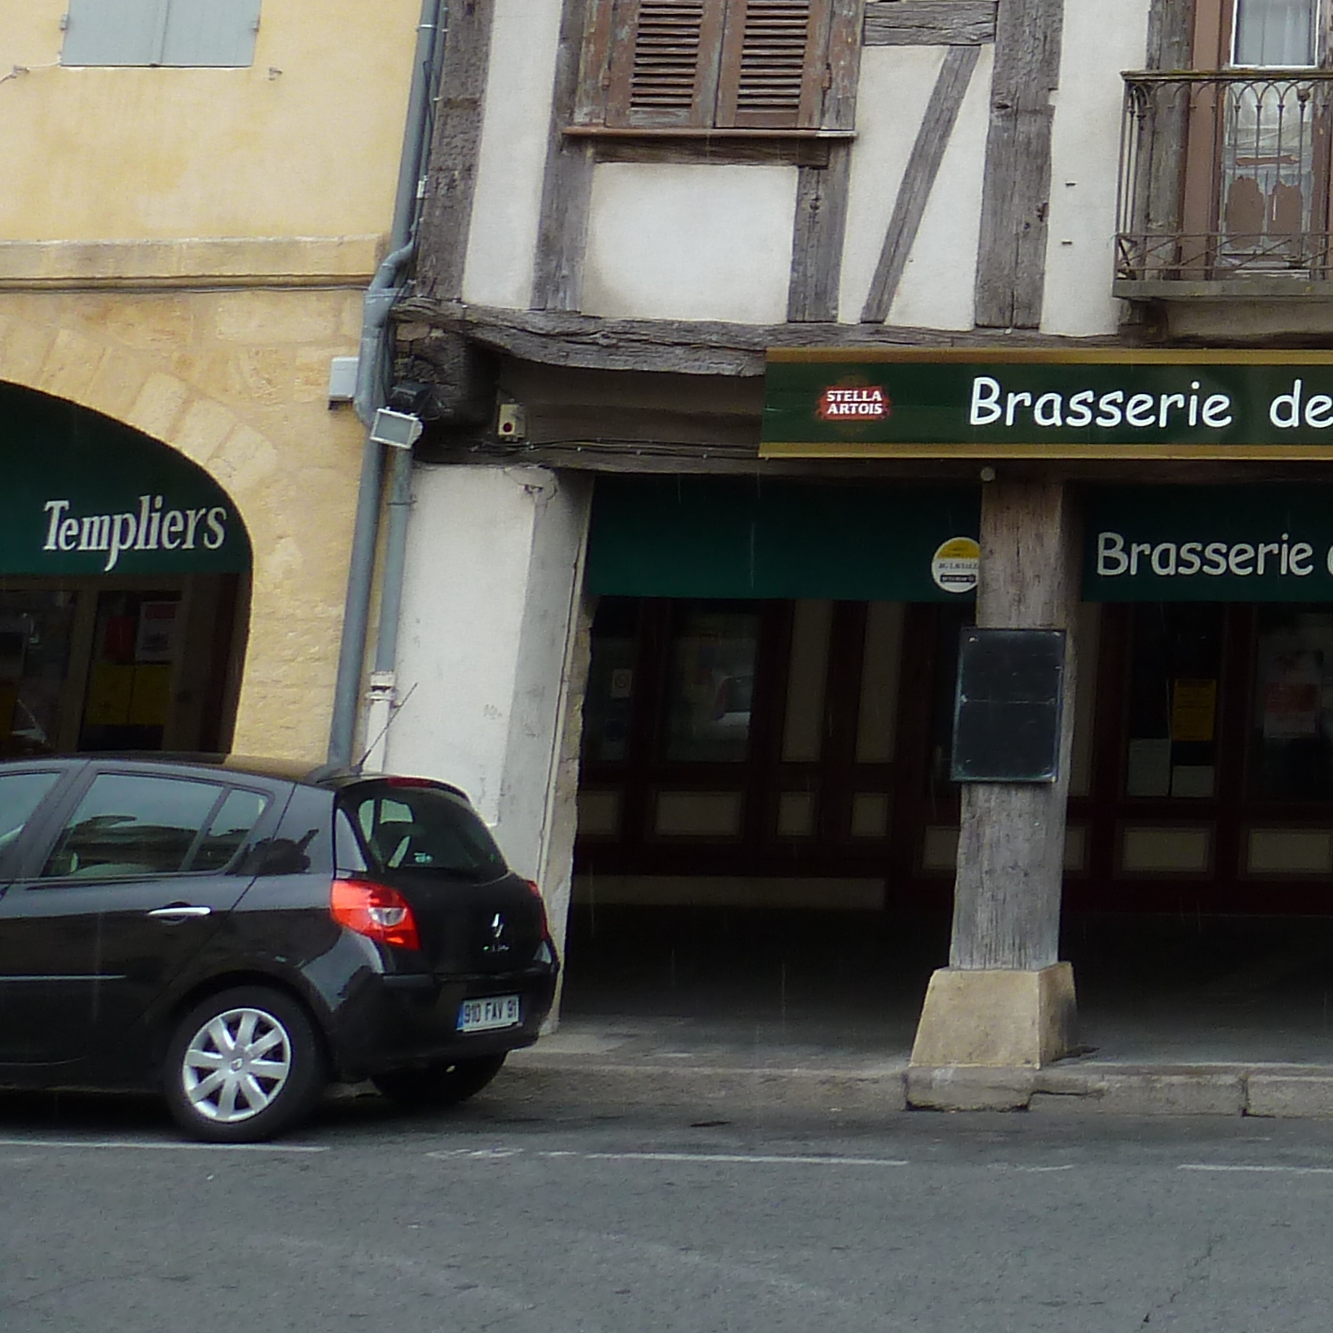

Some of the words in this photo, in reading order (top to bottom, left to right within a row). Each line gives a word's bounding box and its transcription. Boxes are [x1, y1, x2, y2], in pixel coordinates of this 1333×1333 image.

[826, 390, 883, 402] STELLA
[826, 403, 883, 414] ARTOIS
[970, 376, 1232, 428] Brasserie
[42, 495, 227, 571] Templiers
[1097, 532, 1313, 576] Brasserie
[485, 1000, 504, 1021] FAV
